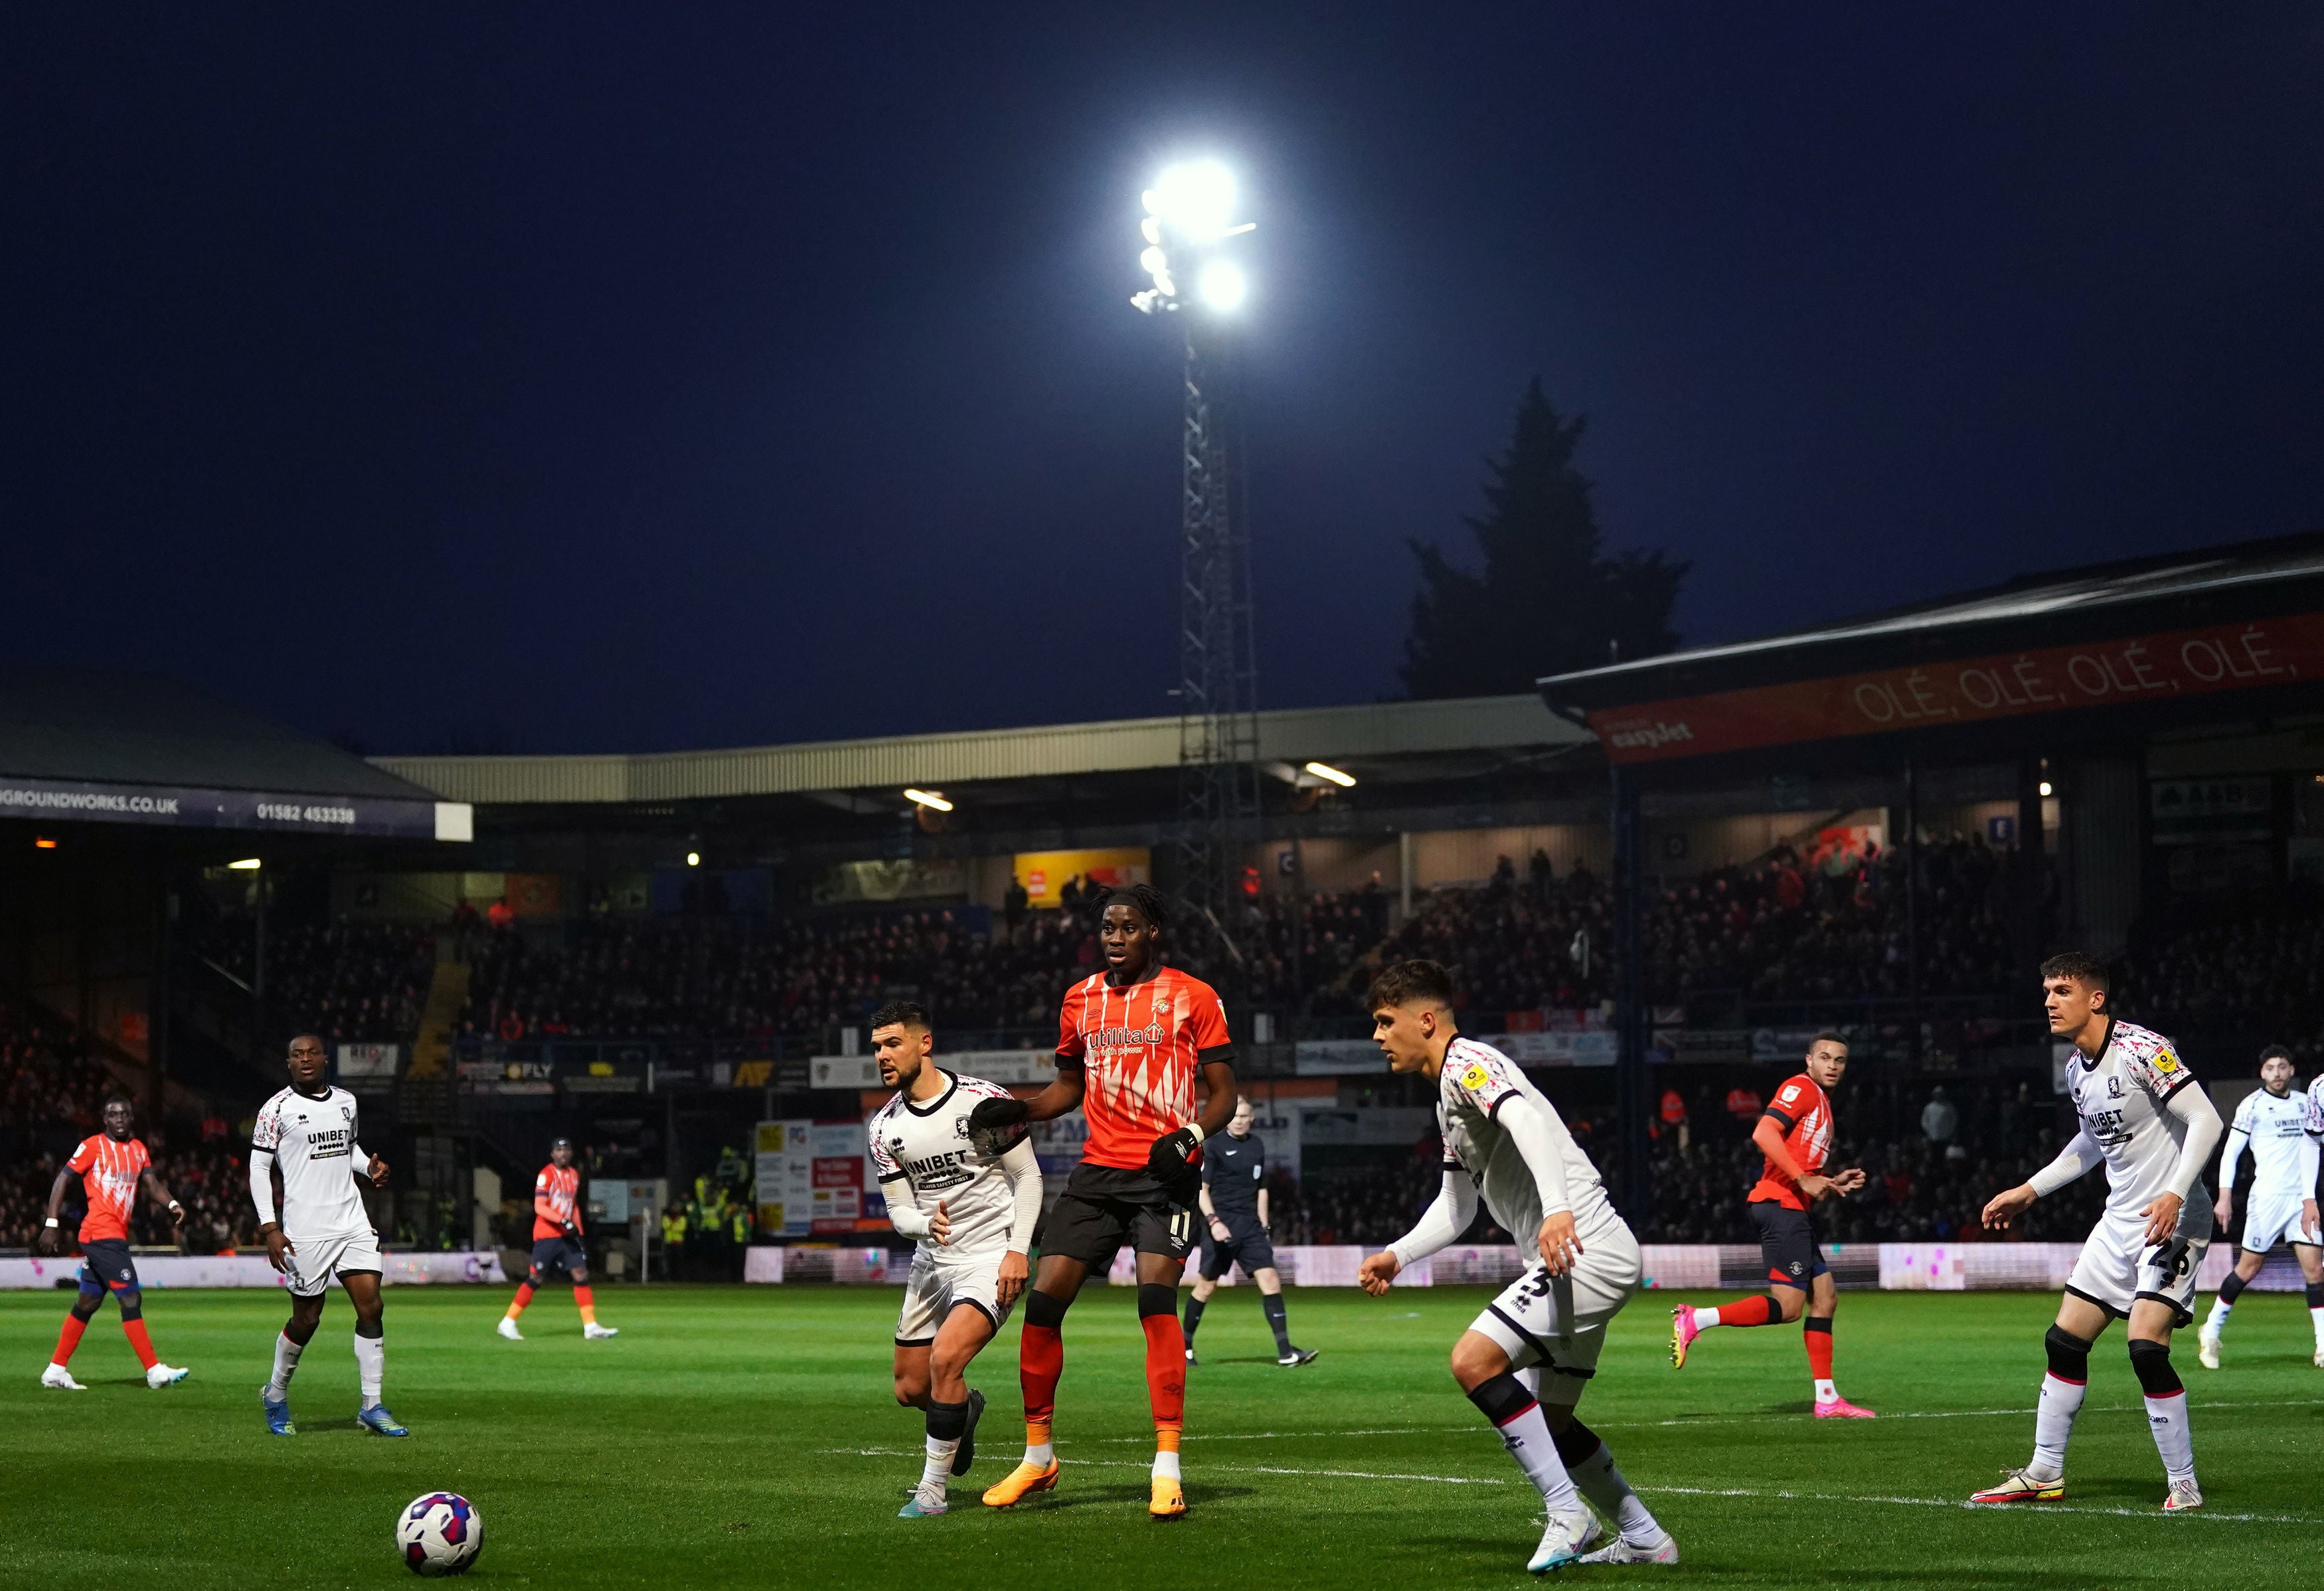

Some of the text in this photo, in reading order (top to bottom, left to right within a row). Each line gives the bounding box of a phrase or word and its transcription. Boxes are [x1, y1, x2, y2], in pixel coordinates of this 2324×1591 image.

[1854, 624, 2298, 722] OLÉ, OLÉ, OLÉ, OLÉ,
[0, 789, 180, 815] GROUNDWORKS.CO.UK
[1090, 1027, 1143, 1048] utilita
[1100, 1047, 1117, 1057] with
[1118, 1047, 1143, 1057] power
[307, 1130, 349, 1144] UNIBET
[905, 1149, 967, 1175] UNIBET
[936, 1179, 954, 1189] SAFETY
[955, 1175, 969, 1185] FIRST
[1169, 1201, 1190, 1242] 11
[2147, 1239, 2191, 1276] 26
